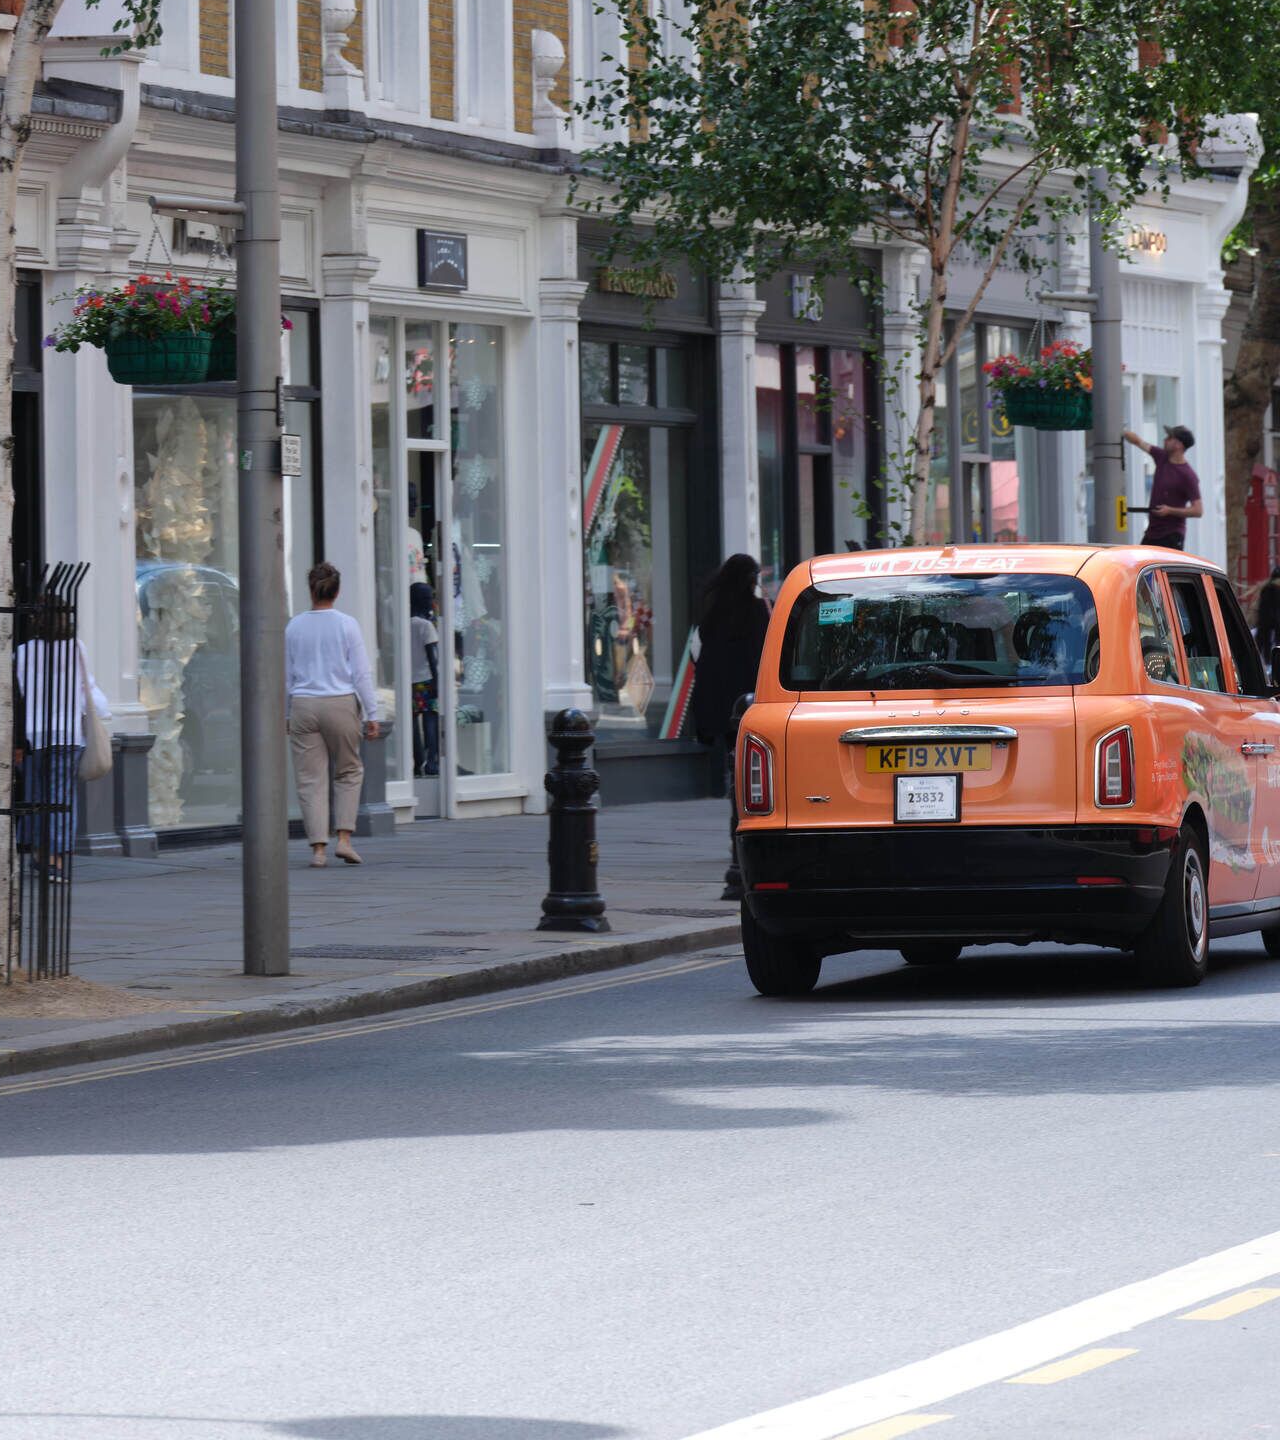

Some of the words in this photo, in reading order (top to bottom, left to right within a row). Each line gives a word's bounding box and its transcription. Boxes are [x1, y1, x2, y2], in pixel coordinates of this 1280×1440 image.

[904, 558, 963, 573] JUST
[971, 558, 1025, 570] EAT
[880, 747, 929, 768] KF19
[934, 746, 977, 767] XVT
[908, 792, 945, 803] 23832
